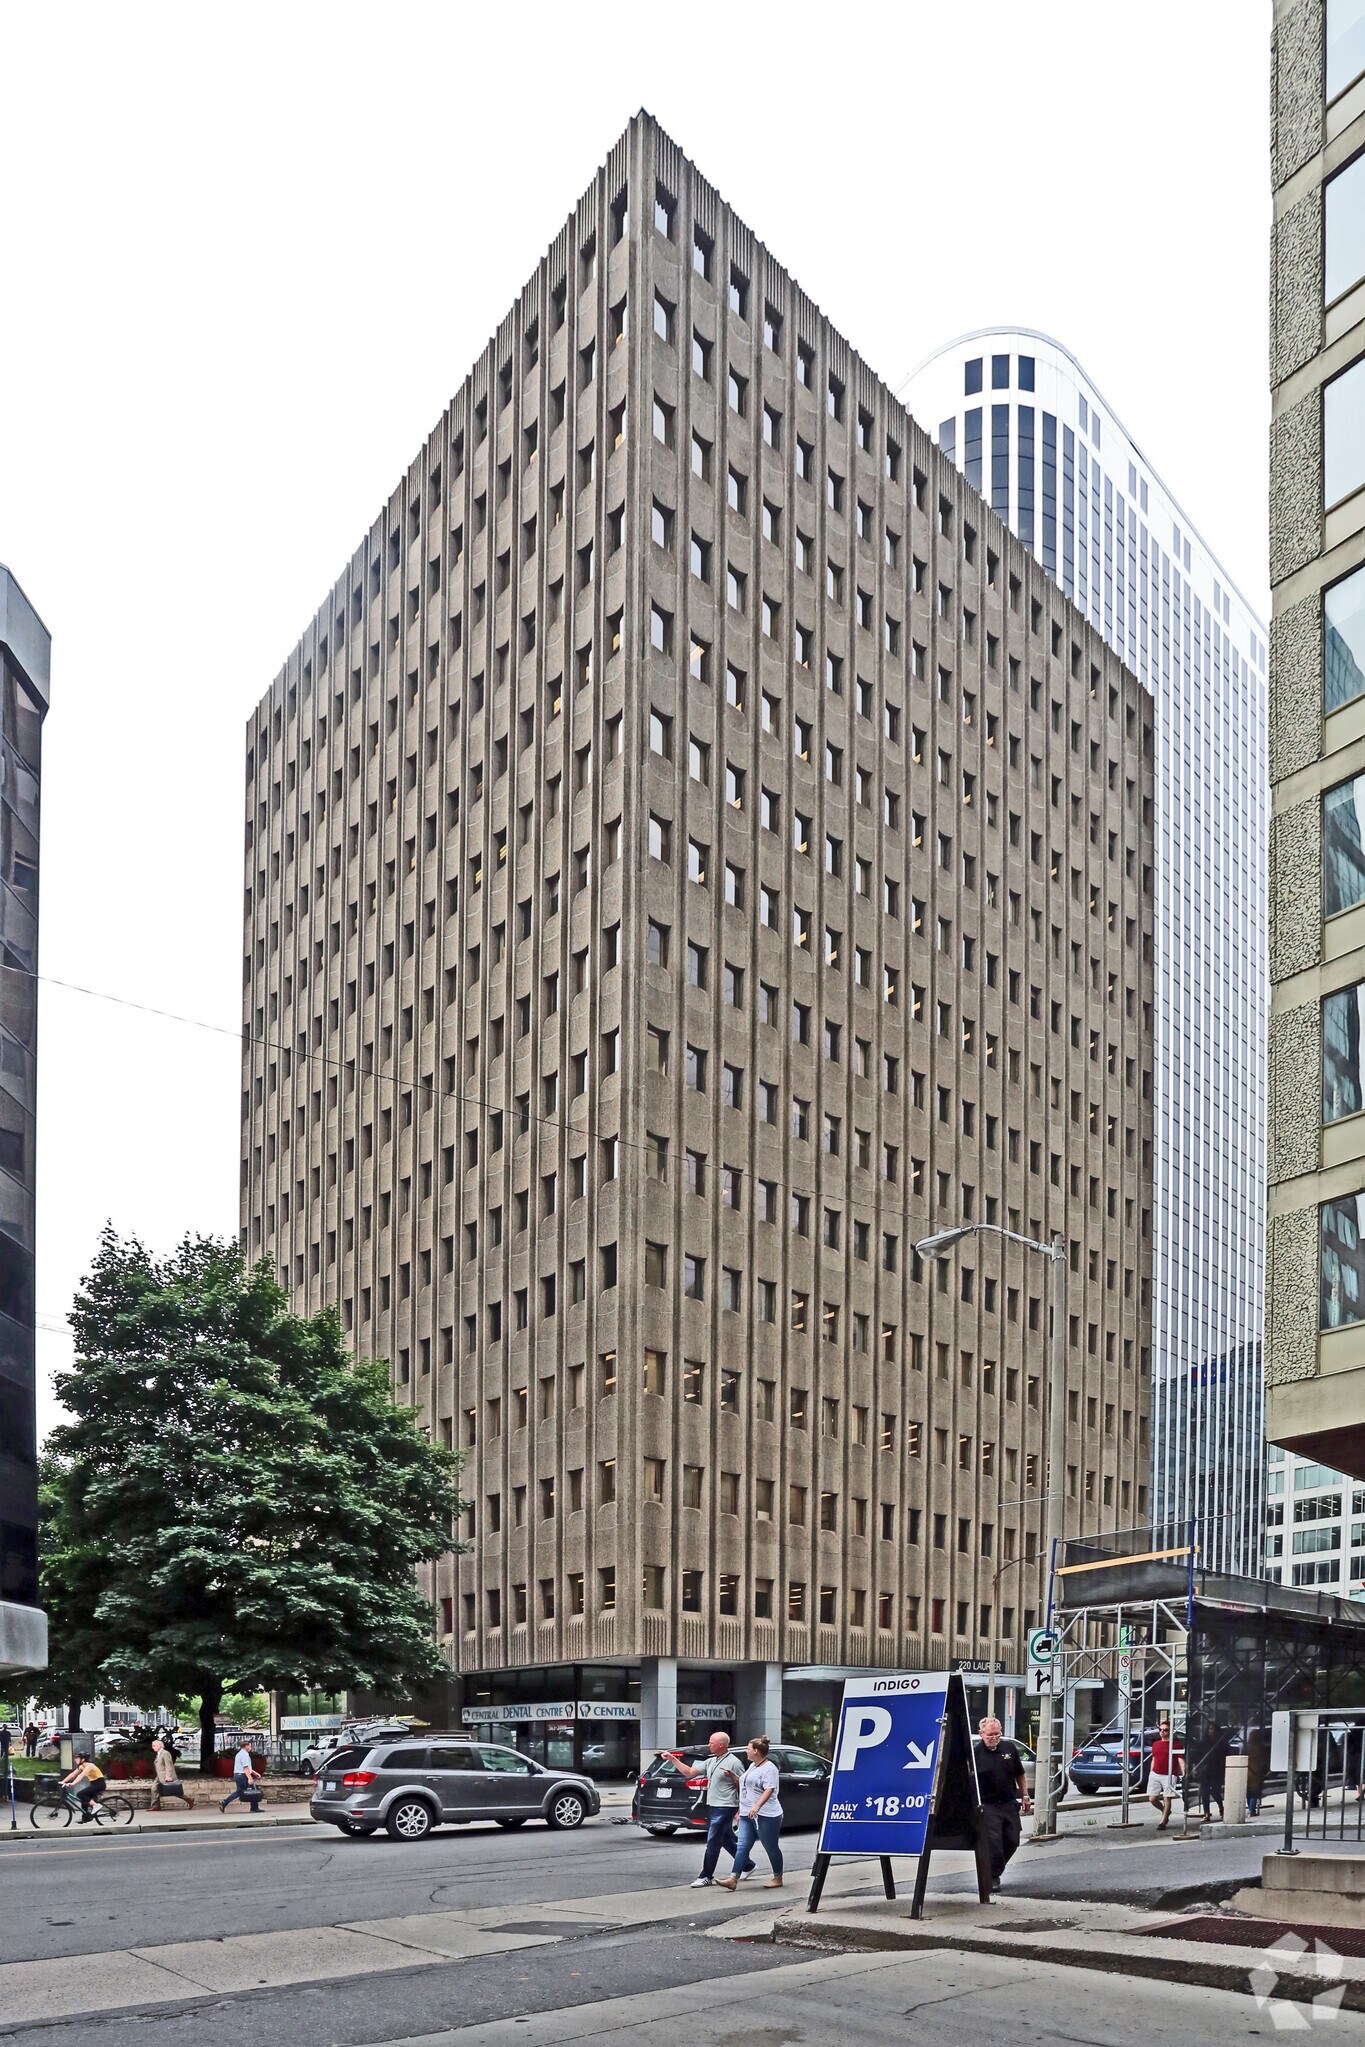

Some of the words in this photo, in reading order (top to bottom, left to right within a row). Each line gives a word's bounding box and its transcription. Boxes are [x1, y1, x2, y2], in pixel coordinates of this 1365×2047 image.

[958, 1660, 971, 1670] 220
[973, 1661, 1002, 1671] LAURER
[873, 1678, 920, 1692] INDIGO
[471, 1710, 499, 1720] CENTRAL
[503, 1706, 532, 1719] DENTAL
[536, 1707, 563, 1717] CENTRE
[594, 1706, 637, 1717] CENTRAL
[691, 1707, 723, 1717] CENTRE
[837, 1705, 893, 1771] P
[832, 1803, 858, 1812] DAILY
[866, 1795, 925, 1817] $18.00
[830, 1812, 854, 1820] MAX.
